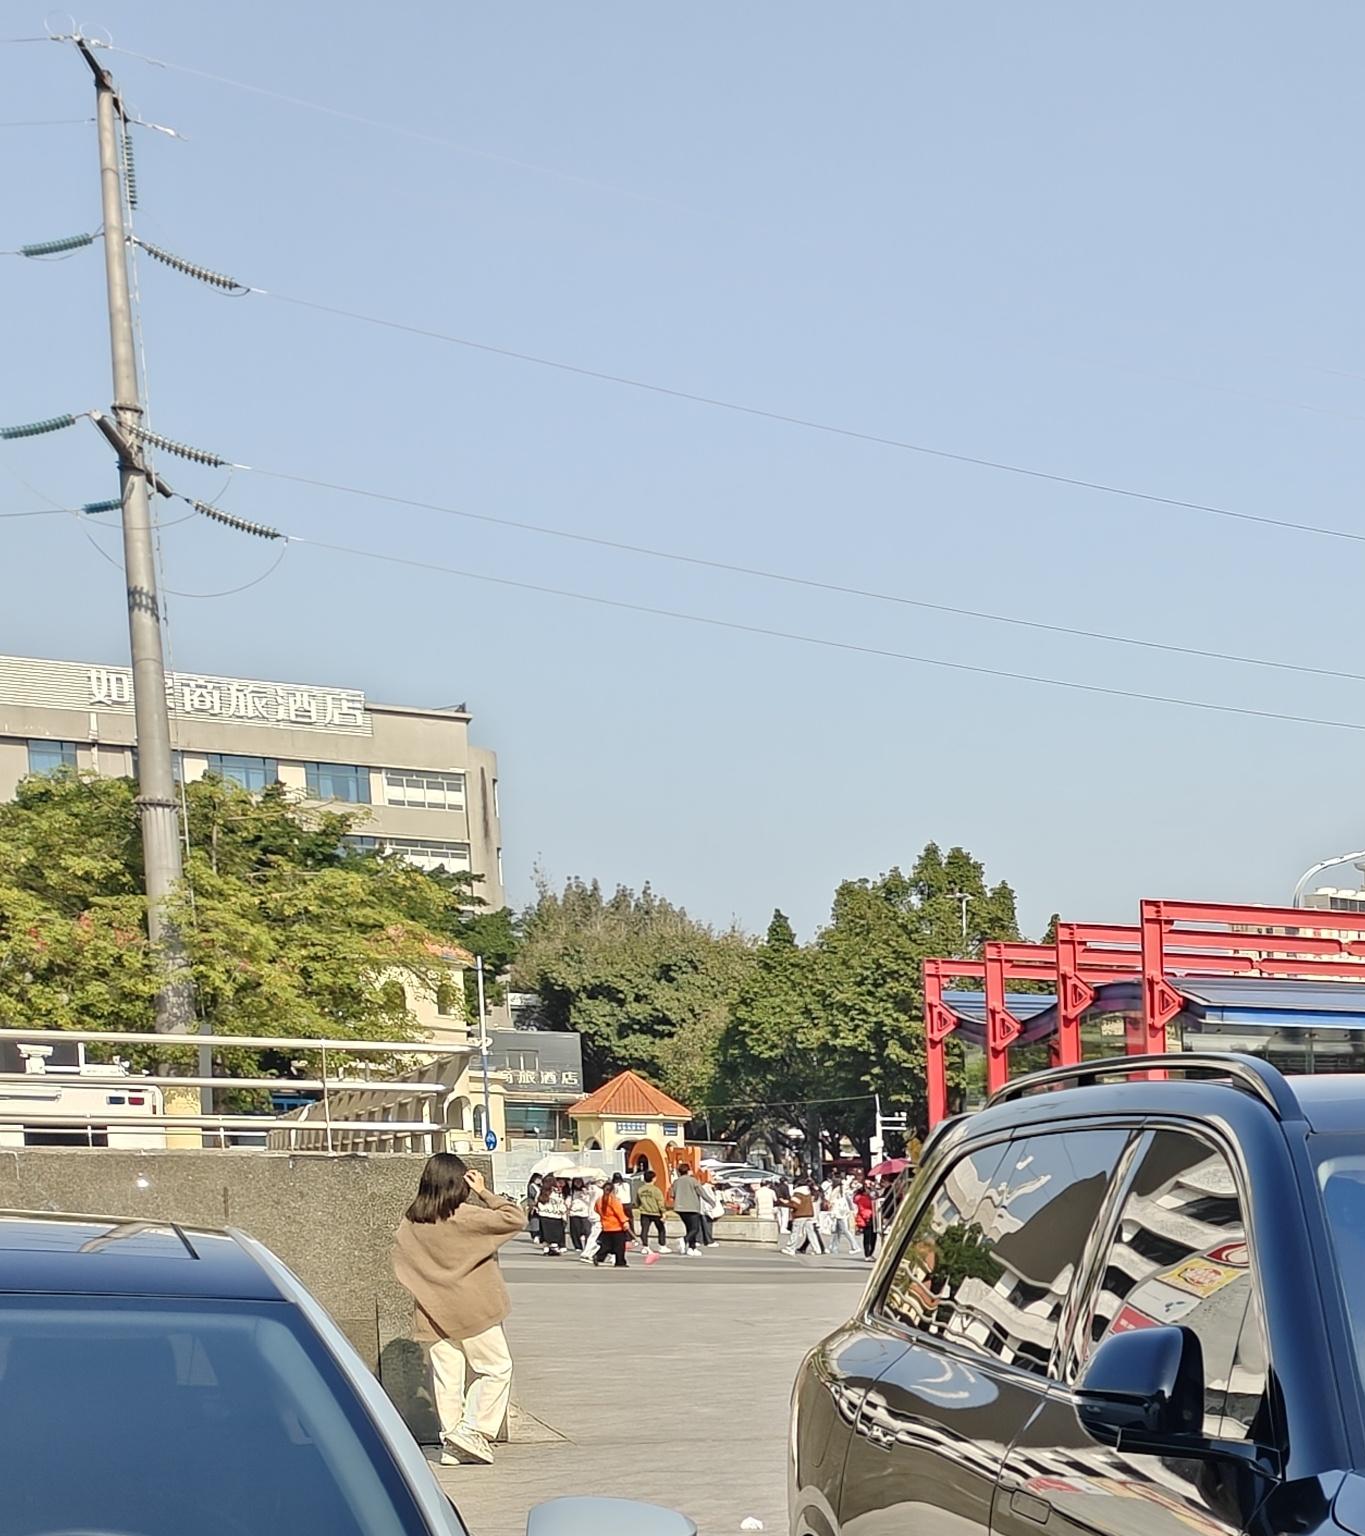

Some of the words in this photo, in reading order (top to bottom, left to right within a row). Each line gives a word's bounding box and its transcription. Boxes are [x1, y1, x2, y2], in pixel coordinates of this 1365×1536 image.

[88, 668, 363, 727] 如商旅酒店
